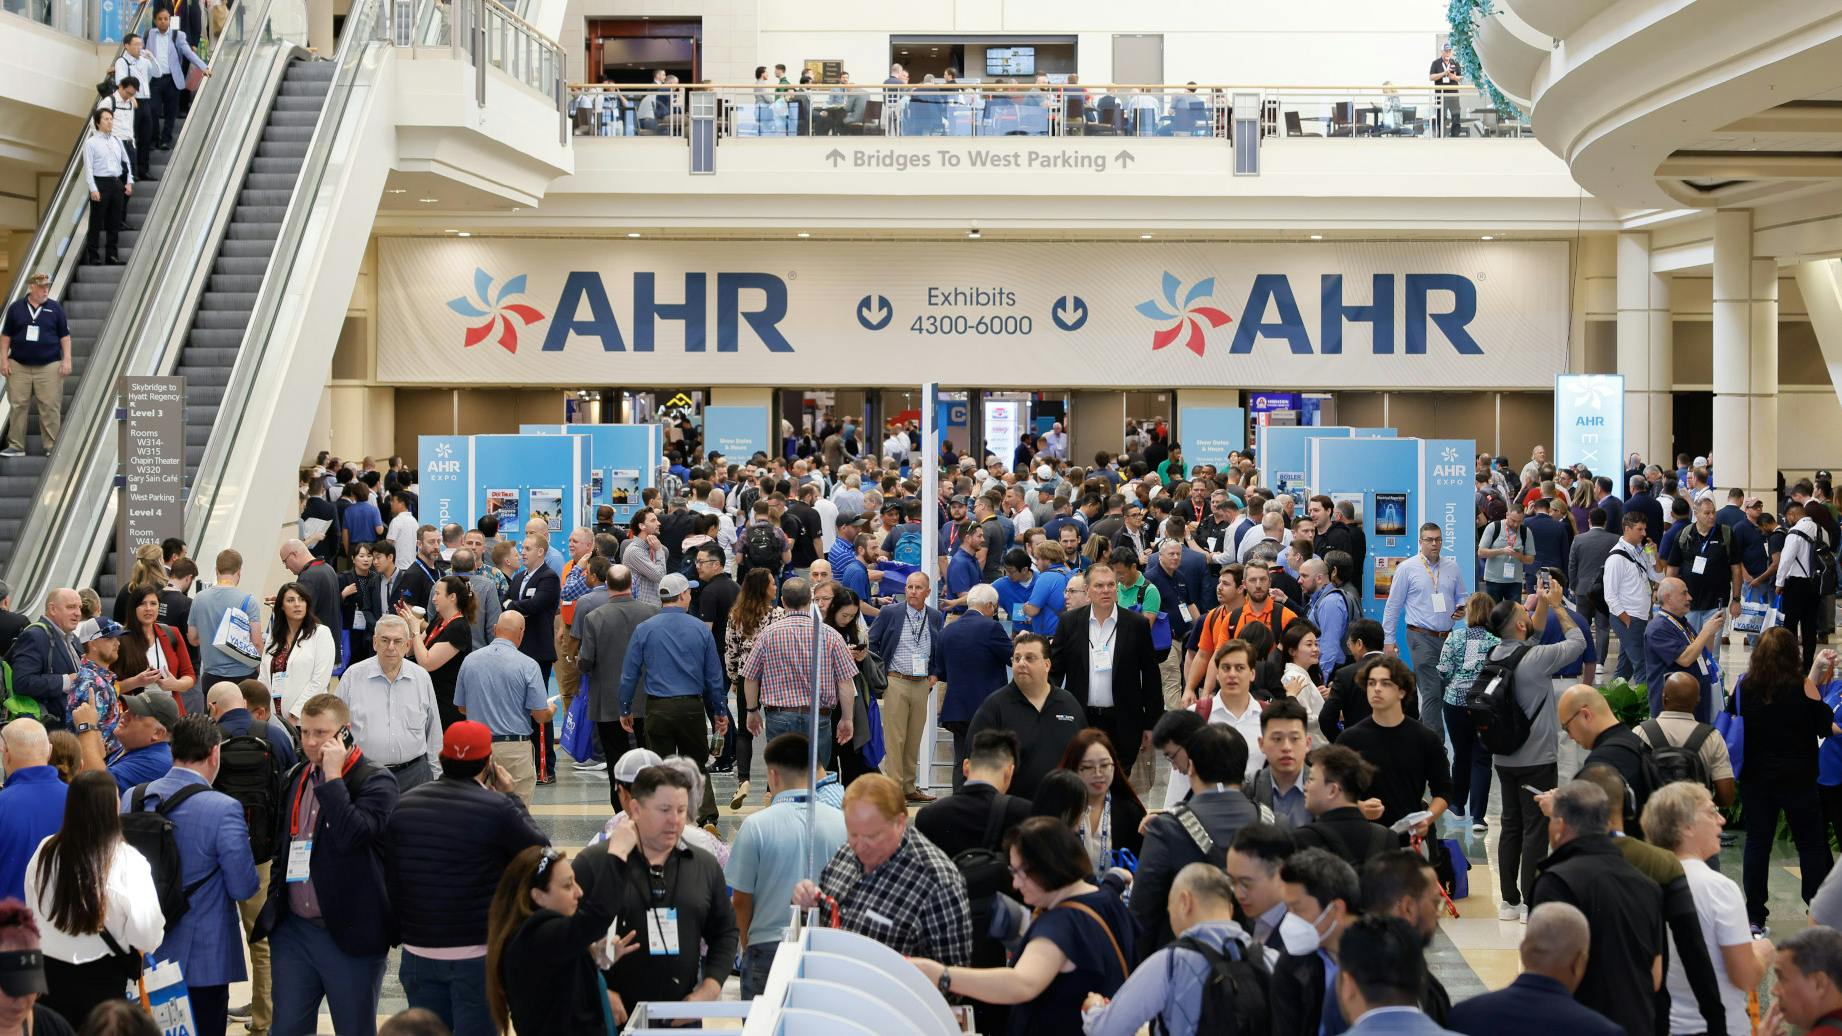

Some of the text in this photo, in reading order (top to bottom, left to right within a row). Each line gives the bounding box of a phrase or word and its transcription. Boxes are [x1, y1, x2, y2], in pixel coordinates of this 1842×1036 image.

[853, 150, 1106, 172] Bridges To West Parking
[927, 287, 1017, 307] Exhibits
[910, 315, 1033, 335] 4300-6000
[131, 384, 167, 392] Skybridge
[128, 393, 180, 402] Hyatt Regency
[131, 409, 163, 417] Level 3
[1576, 416, 1605, 426] AHR
[130, 429, 159, 437] Rooms
[137, 438, 164, 446] W314-
[137, 447, 161, 456] W315
[130, 456, 180, 466] Chapin Theater
[137, 465, 161, 474] W320
[427, 460, 461, 473] AHR
[1433, 464, 1466, 477] AHR
[127, 474, 178, 483] Gary Sain Café
[130, 493, 175, 503] West Parking
[129, 508, 162, 516] Level 4
[129, 528, 154, 536] Room
[1443, 503, 1457, 553] Industry
[135, 537, 160, 545] W414
